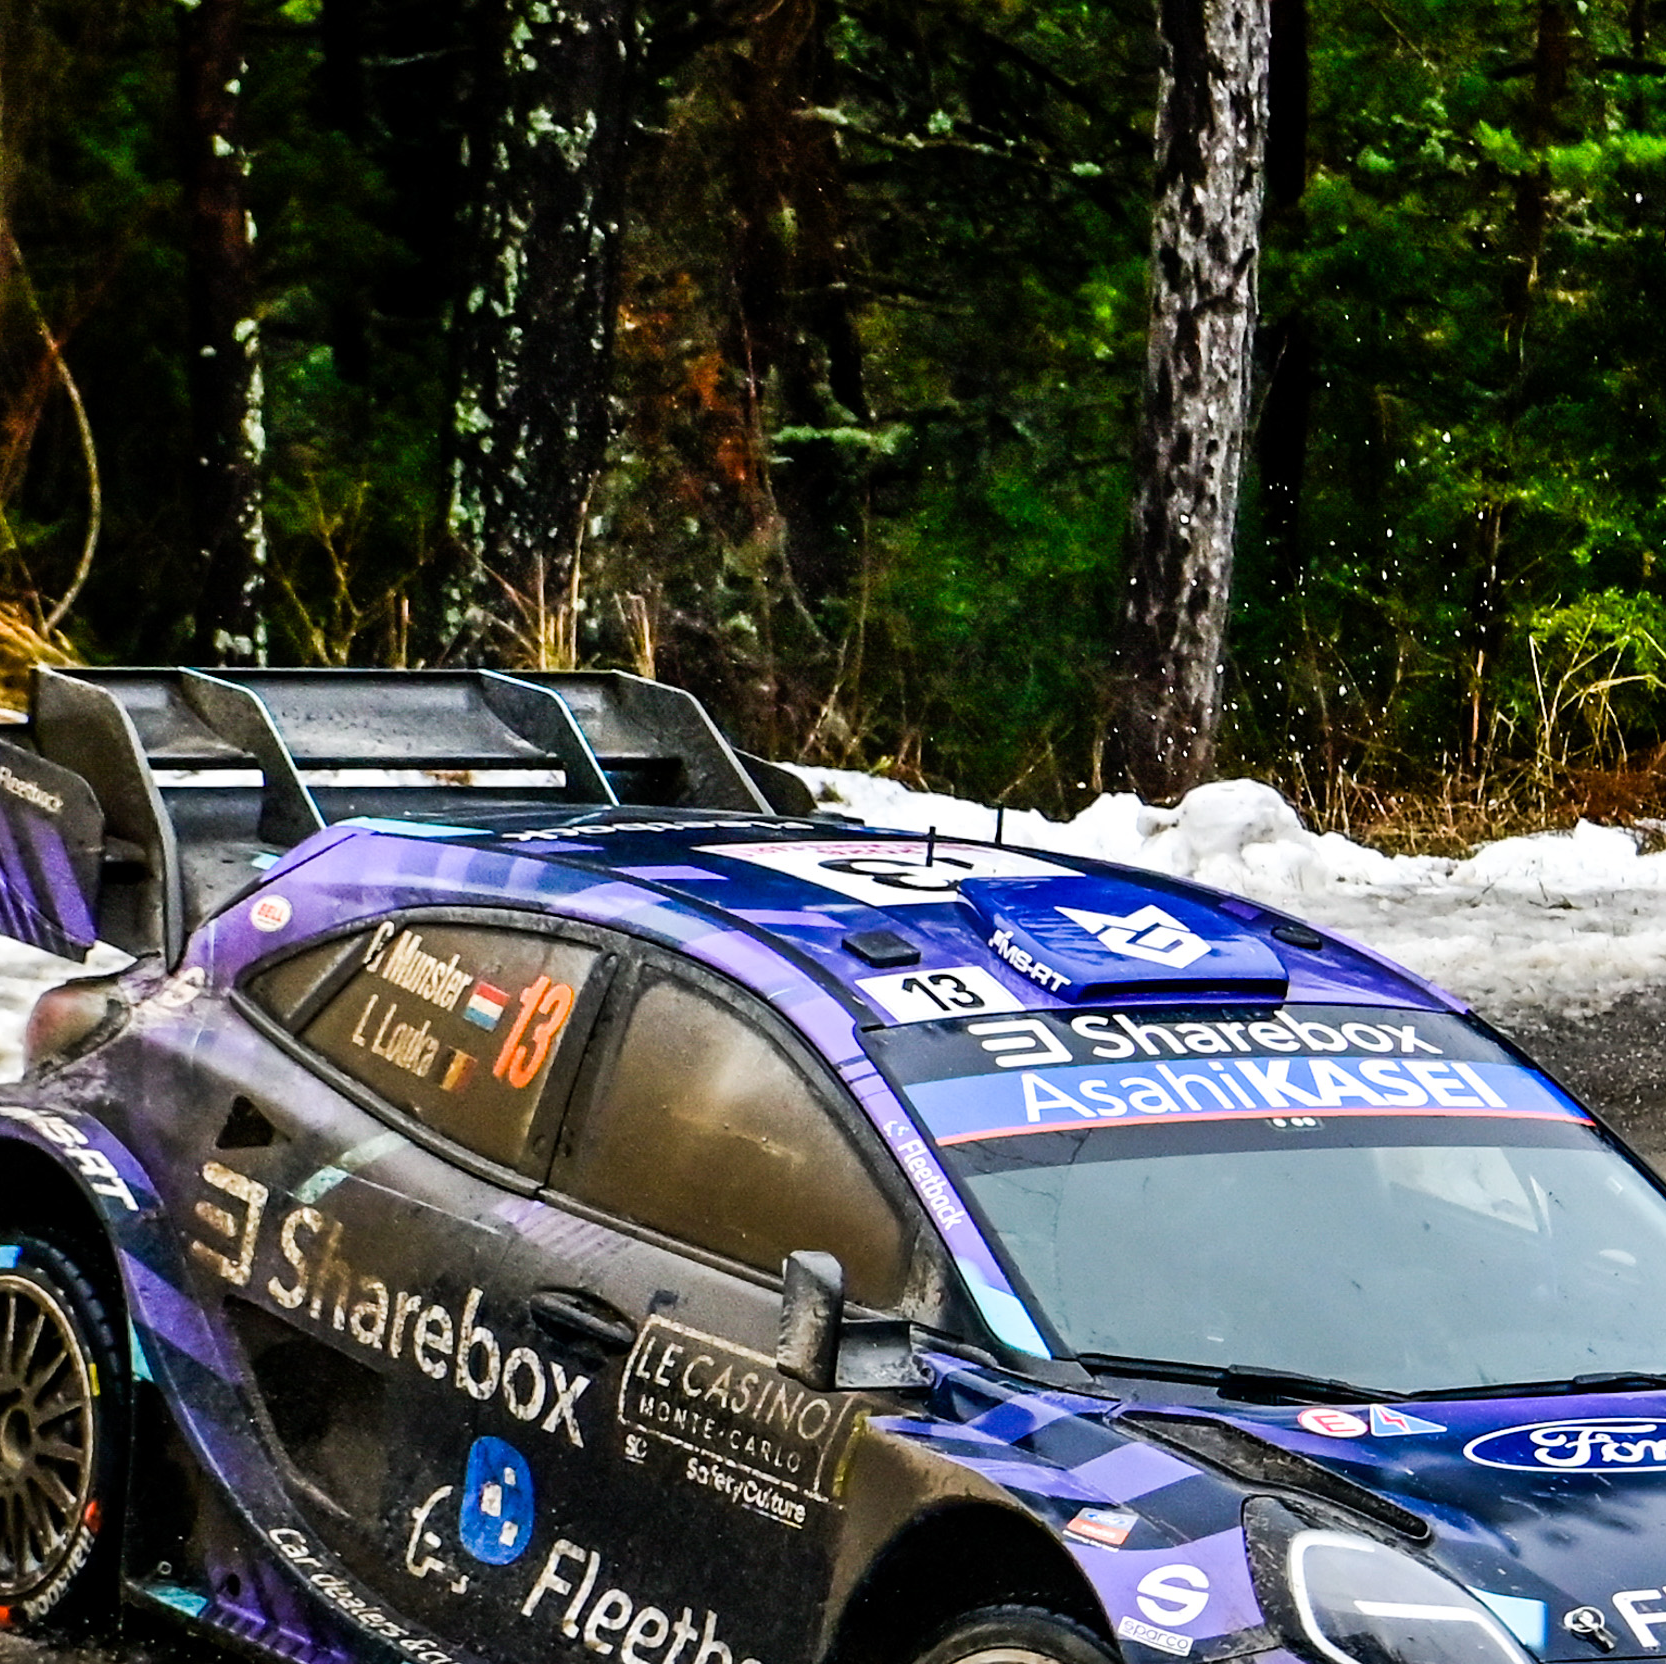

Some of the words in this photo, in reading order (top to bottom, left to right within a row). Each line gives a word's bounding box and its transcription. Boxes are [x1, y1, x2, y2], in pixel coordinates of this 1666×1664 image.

[381, 929, 475, 1012] Munster
[901, 974, 986, 1012] 13
[997, 938, 1073, 993] MS-RT
[491, 975, 575, 1089] 13
[1070, 1012, 1444, 1057] Sharebox
[1020, 1059, 1509, 1123] AsahiKASEI
[896, 1138, 967, 1231] Fleetback
[267, 1205, 592, 1450] Sharebox
[682, 1354, 832, 1441] CASINO
[268, 1527, 323, 1569] Car
[310, 1572, 410, 1638] dealers
[1123, 1618, 1190, 1651] sparco
